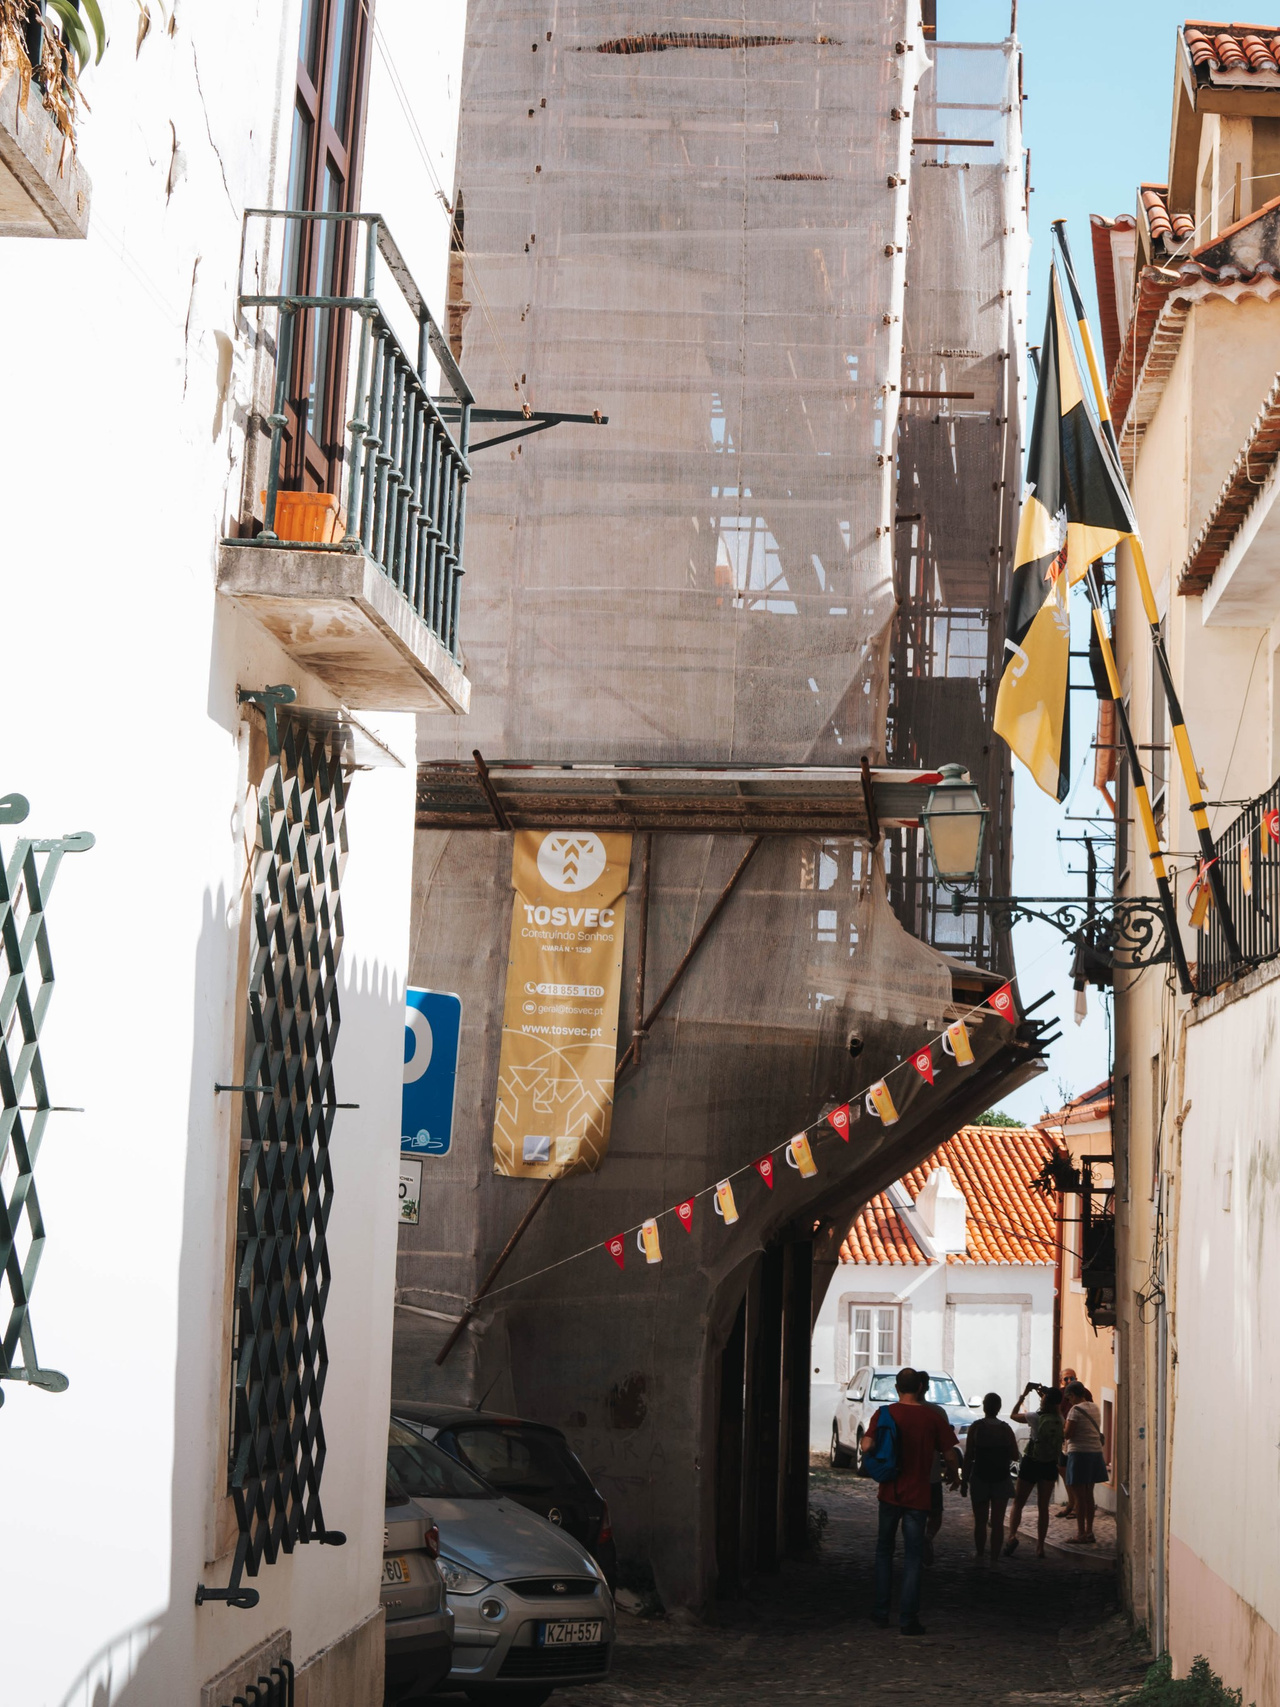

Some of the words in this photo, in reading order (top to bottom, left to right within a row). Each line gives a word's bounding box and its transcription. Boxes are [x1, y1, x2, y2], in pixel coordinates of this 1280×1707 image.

[523, 904, 615, 928] TOSVEC
[577, 930, 614, 942] Sonhos
[540, 984, 558, 995] 218
[560, 985, 579, 996] 855
[582, 986, 602, 997] 160
[537, 1003, 604, 1017] geral@tosvec.pt
[521, 1024, 602, 1039] www.tosvec.pt
[547, 1623, 599, 1643] KZH-557
